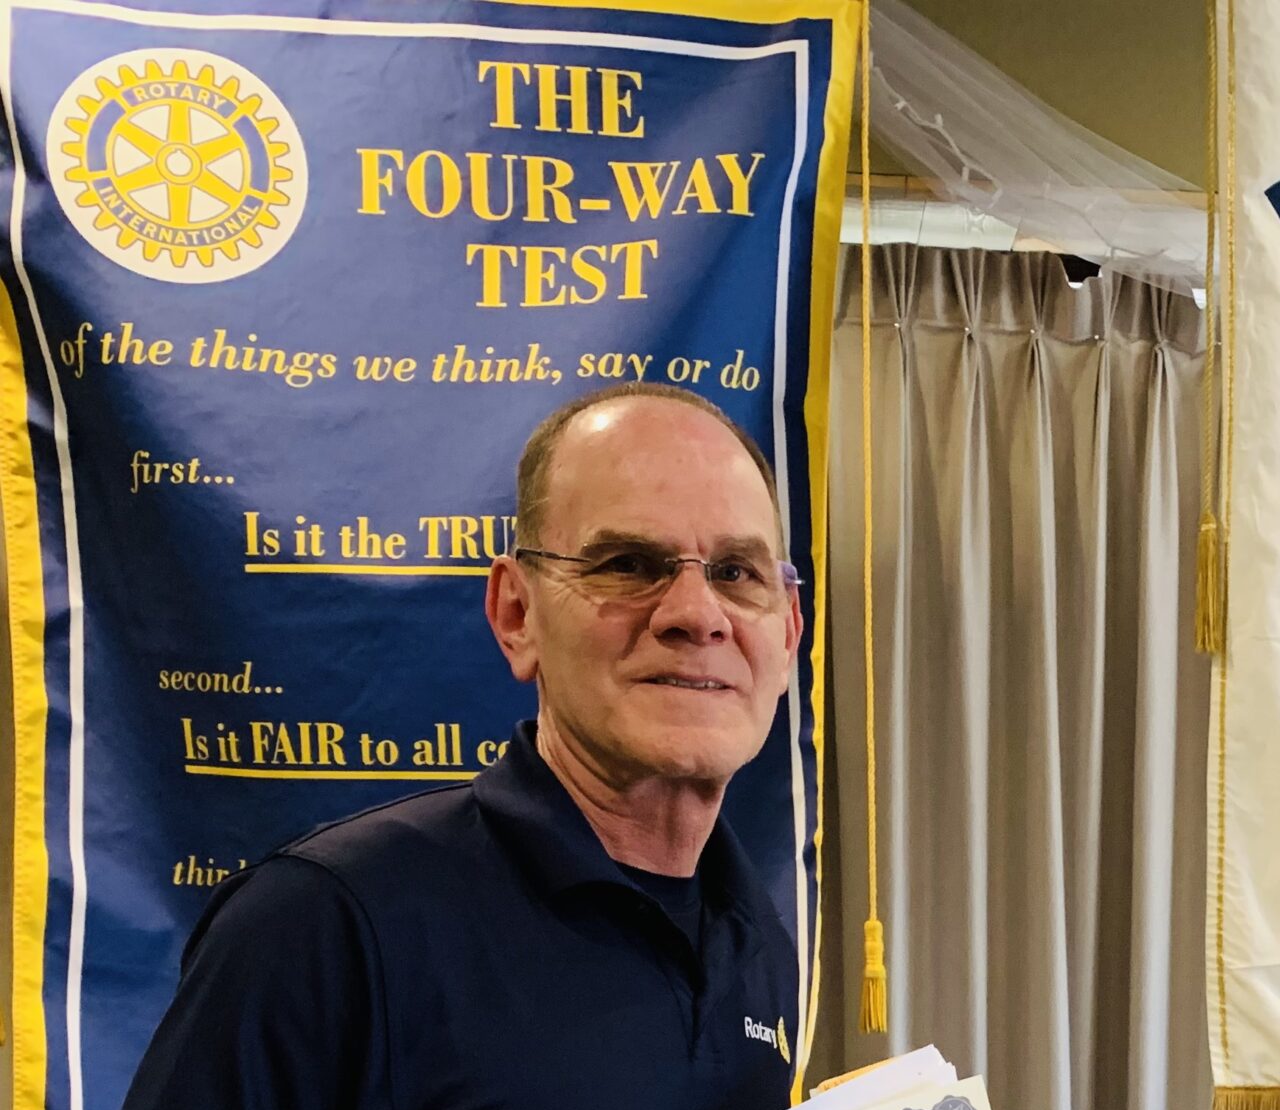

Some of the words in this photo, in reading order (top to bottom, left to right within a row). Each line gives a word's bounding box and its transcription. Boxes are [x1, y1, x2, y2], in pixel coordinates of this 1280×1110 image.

[132, 82, 228, 112] ROTARY
[478, 61, 645, 138] THE
[356, 149, 766, 224] FOUR-WAY
[99, 185, 260, 247] INTERNATIONAL
[467, 240, 658, 308] TEST
[60, 322, 93, 379] of
[100, 322, 174, 365] the
[189, 329, 337, 388] things
[353, 355, 417, 382] we
[431, 343, 562, 386] think,
[577, 351, 653, 382] say
[667, 356, 710, 383] or
[720, 350, 761, 391] do
[131, 450, 235, 492] first...
[243, 511, 280, 557] Is
[293, 515, 325, 557] it
[339, 516, 406, 560] the
[418, 515, 518, 559] TRU
[158, 661, 284, 694] second...
[181, 717, 209, 761] Is
[216, 722, 241, 763] it
[249, 721, 347, 766] FAIR
[359, 732, 399, 766] to
[412, 722, 463, 766] all
[172, 854, 246, 887] thir
[744, 1016, 777, 1049] Rotary
